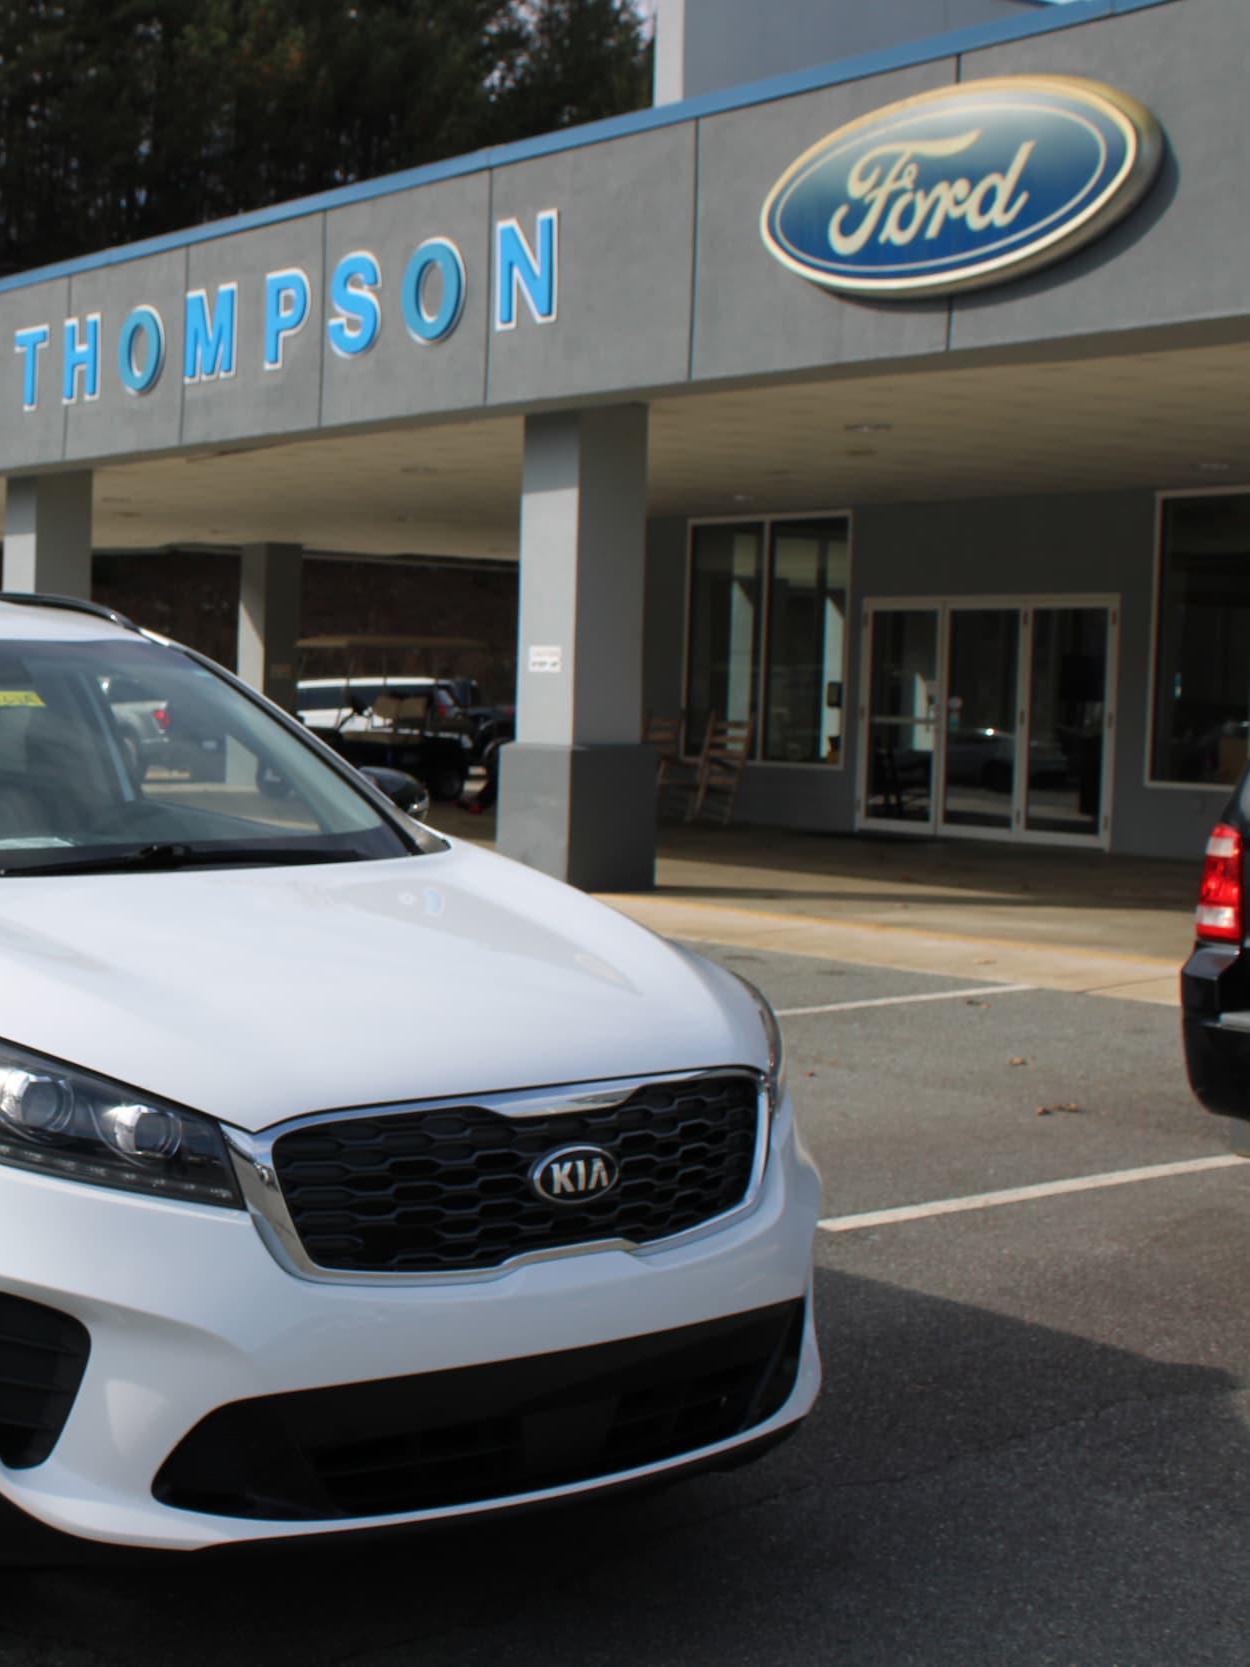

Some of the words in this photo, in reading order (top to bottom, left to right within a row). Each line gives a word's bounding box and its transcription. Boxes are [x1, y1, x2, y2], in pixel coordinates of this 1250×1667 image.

[828, 128, 1037, 256] Ford
[14, 209, 560, 412] THOMPSON
[550, 1158, 609, 1194] KIA
